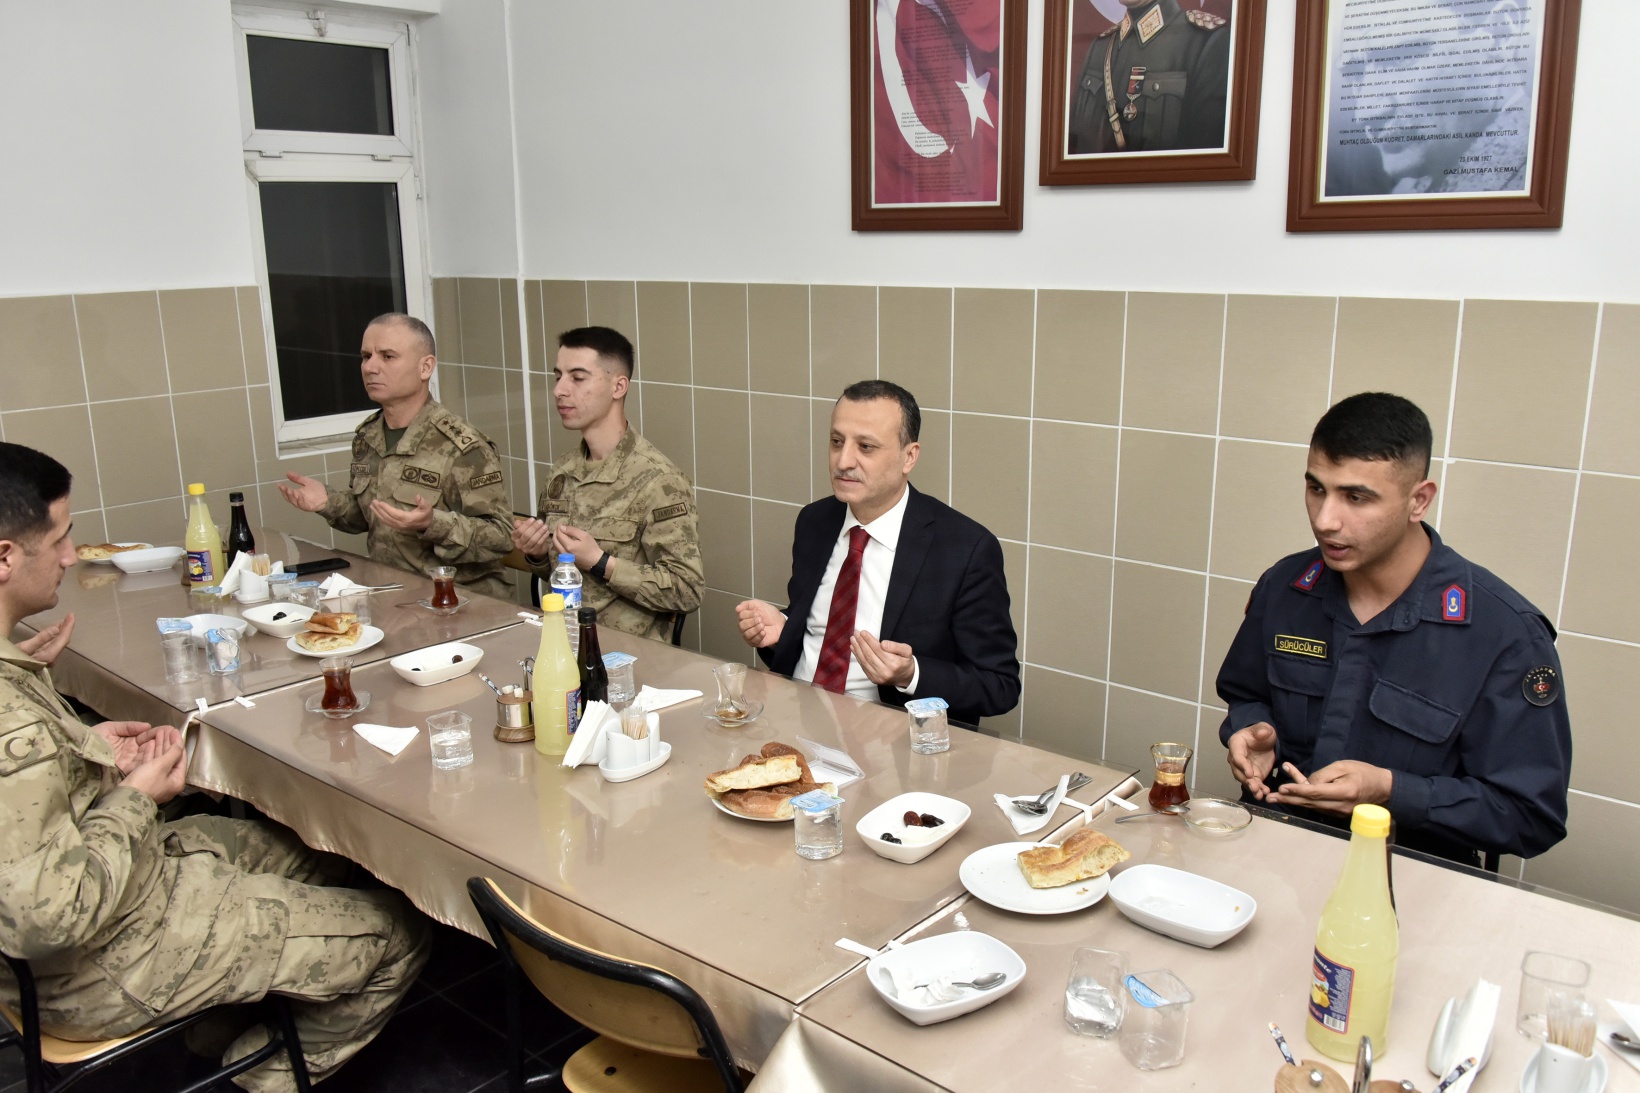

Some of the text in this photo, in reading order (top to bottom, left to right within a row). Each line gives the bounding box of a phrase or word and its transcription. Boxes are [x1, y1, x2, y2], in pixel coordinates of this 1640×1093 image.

[1406, 133, 1451, 142] DAMARLARINDAKİ
[1464, 131, 1483, 139] KANDA
[1460, 166, 1492, 174] MUSTAFA
[1493, 165, 1518, 173] KEMAL
[1279, 640, 1323, 654] SÜRÜCÜLER
